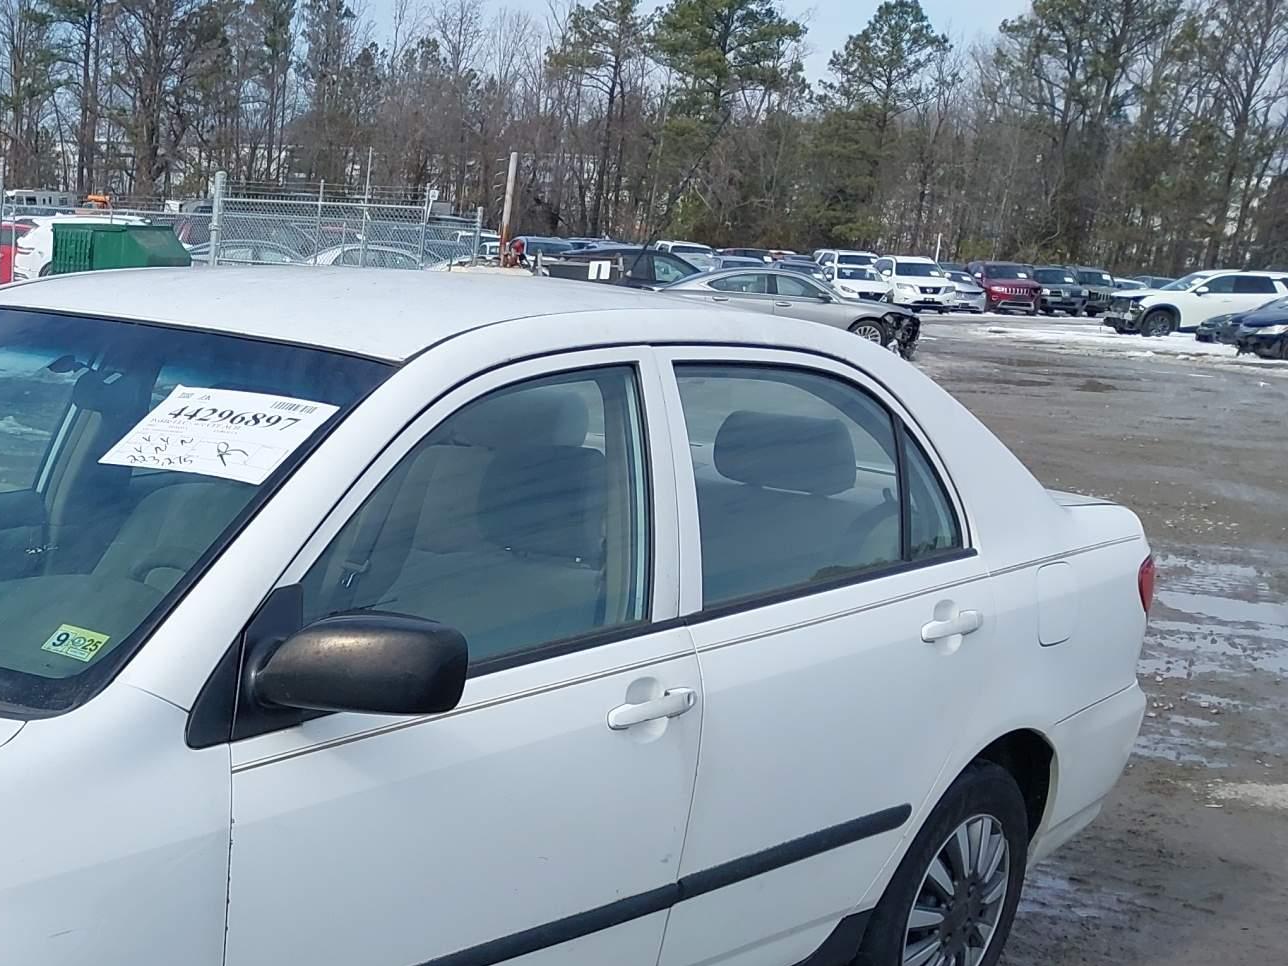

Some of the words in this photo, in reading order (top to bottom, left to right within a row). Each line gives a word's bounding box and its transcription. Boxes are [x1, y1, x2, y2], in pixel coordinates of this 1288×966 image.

[168, 404, 302, 431] 44296897
[52, 632, 70, 647] 9
[81, 638, 103, 652] 25
